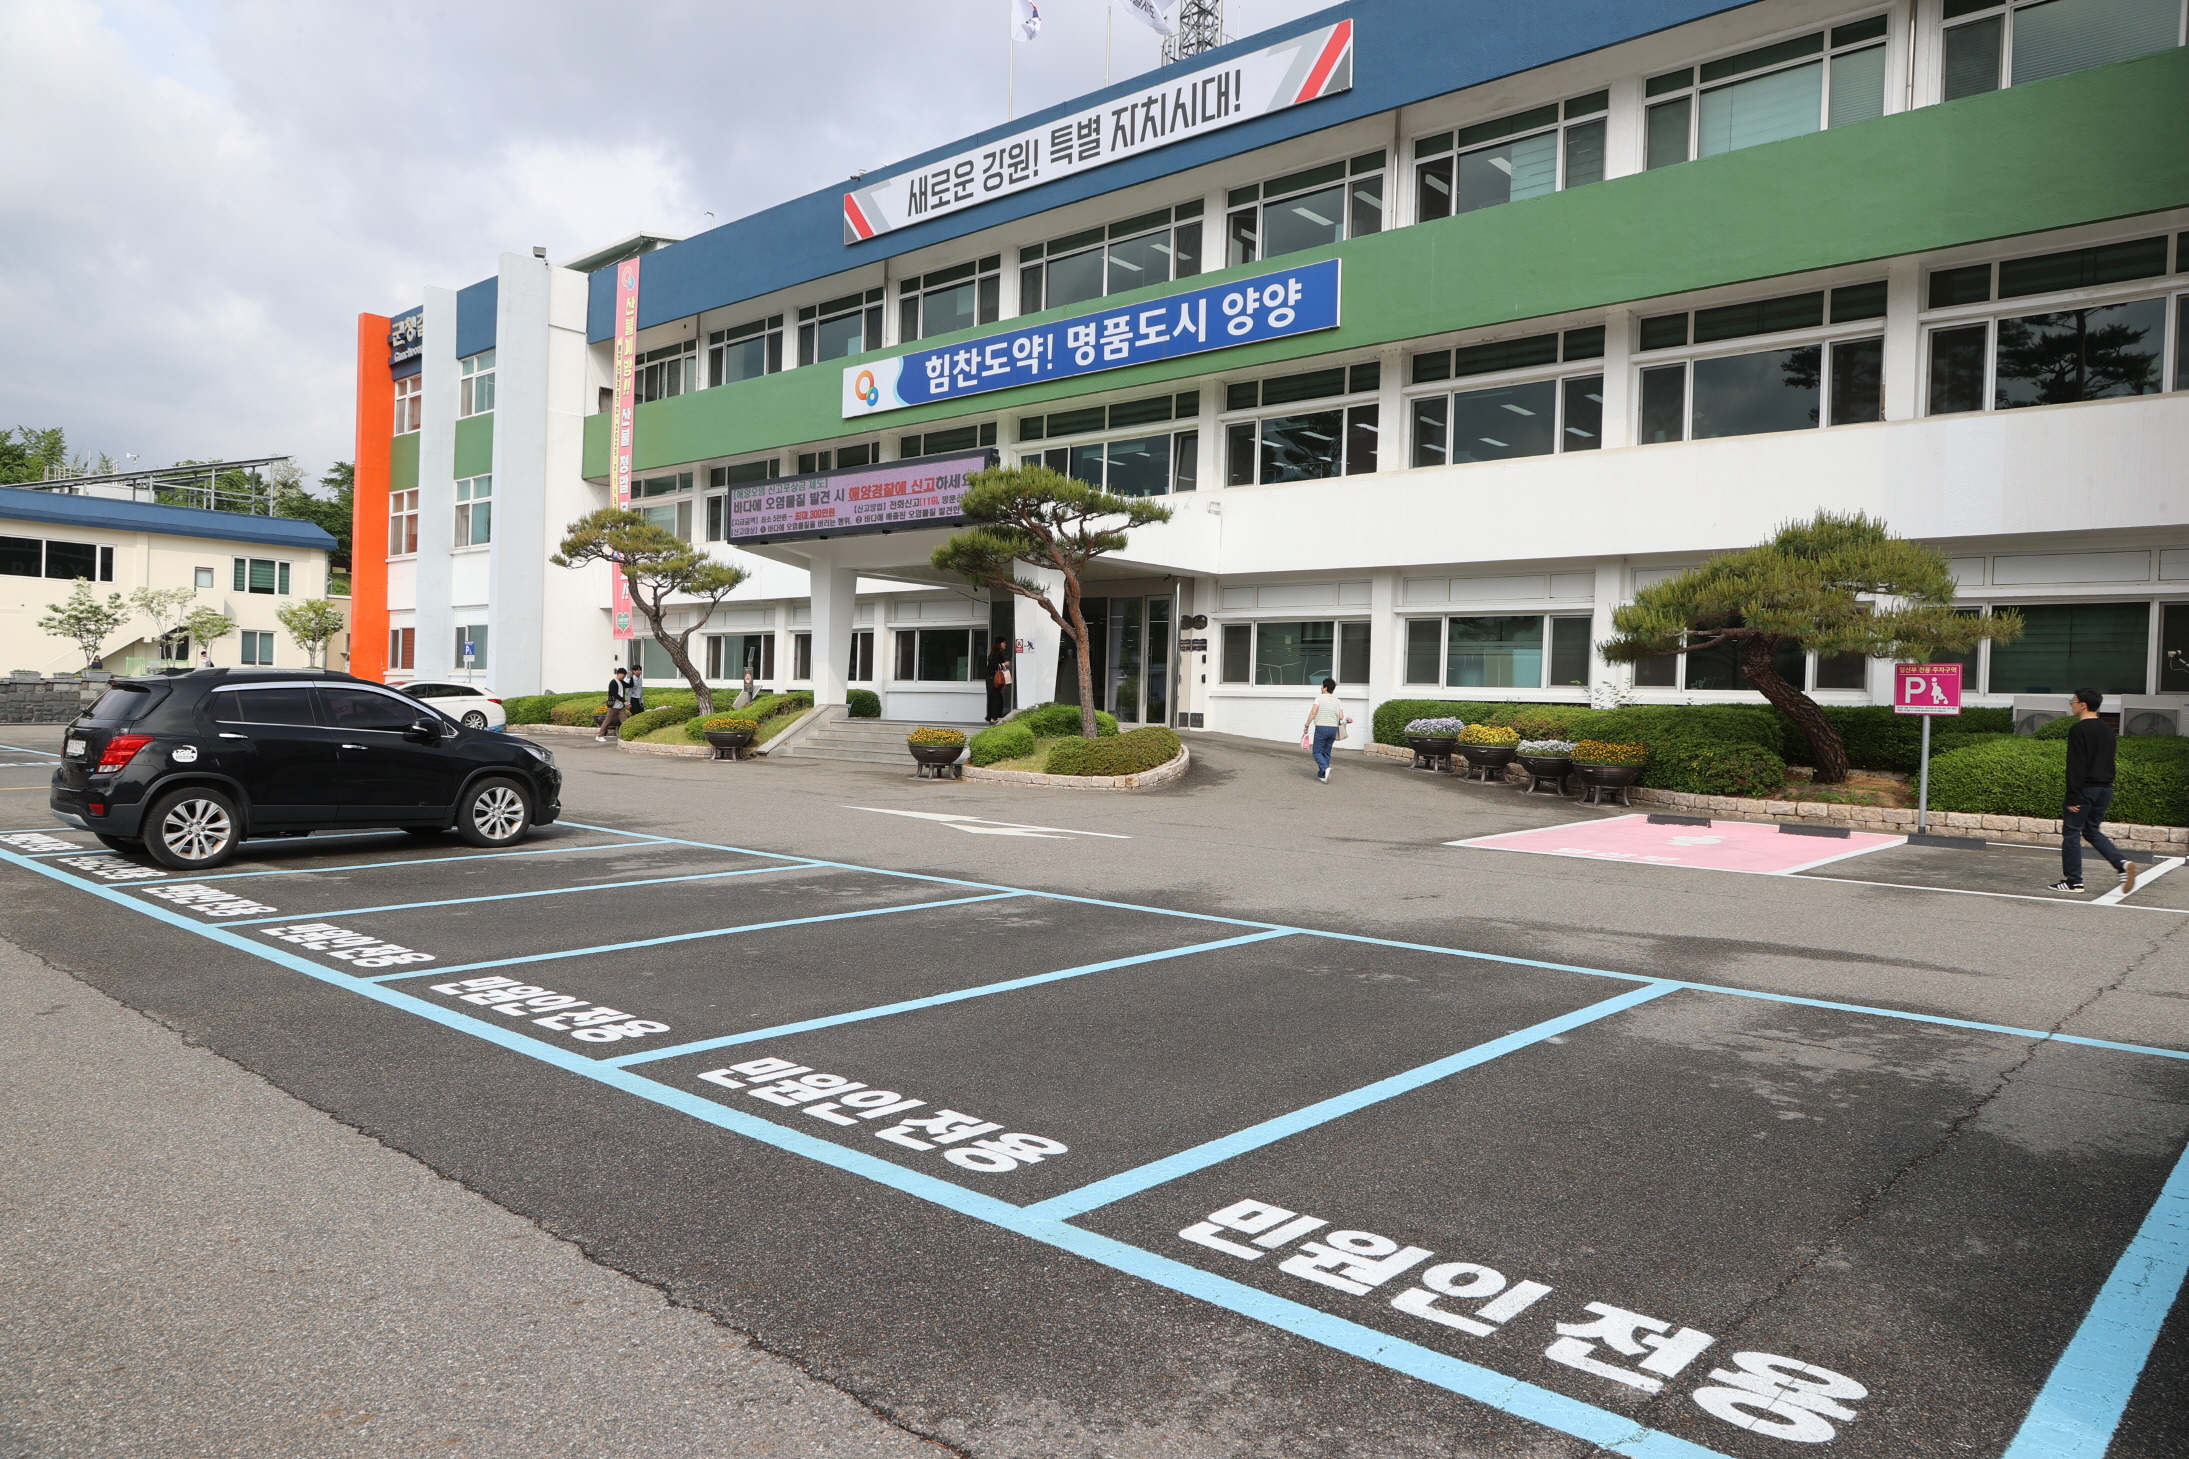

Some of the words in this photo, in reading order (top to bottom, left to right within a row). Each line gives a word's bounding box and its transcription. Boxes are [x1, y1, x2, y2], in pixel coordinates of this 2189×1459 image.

[908, 158, 975, 217] 새로운
[983, 138, 1039, 192] 강원!
[1050, 114, 1101, 165] 특별
[1111, 69, 1241, 152] 자치시대!
[925, 334, 1053, 395] 힘찬도약!
[1066, 298, 1207, 366] 명품도시
[1223, 277, 1302, 336] 양양
[620, 407, 632, 447] 산불
[619, 454, 630, 494] 정말
[733, 486, 766, 499] [해양오염
[768, 481, 806, 496] 신고포상금
[808, 478, 828, 490] 제도]
[733, 499, 762, 514] 바다에
[765, 493, 806, 510] 오염물질
[810, 490, 830, 505] 발견
[834, 488, 845, 502] 시
[848, 481, 907, 501] 해양경찰에
[761, 515, 772, 524] 최소
[773, 514, 787, 522] 5만원
[795, 511, 808, 520] 최대
[809, 508, 835, 519] 300만원
[854, 502, 886, 514] [신고방법]
[731, 526, 758, 536] [신고대상]
[767, 523, 784, 533] 바다에
[786, 520, 815, 530] 오염물질을
[817, 518, 836, 527] 버리는
[864, 513, 883, 523] 바다에
[886, 511, 906, 521] 배출된
[908, 508, 936, 519] 오염물질
[938, 505, 960, 516] 발견한
[1899, 666, 1917, 674] 임산부
[1918, 666, 1931, 674] 전용
[1932, 666, 1958, 674] 주차구역
[1904, 676, 1927, 704] P
[1179, 1199, 1553, 1338] 민원인
[1542, 1301, 1868, 1443] 전용
